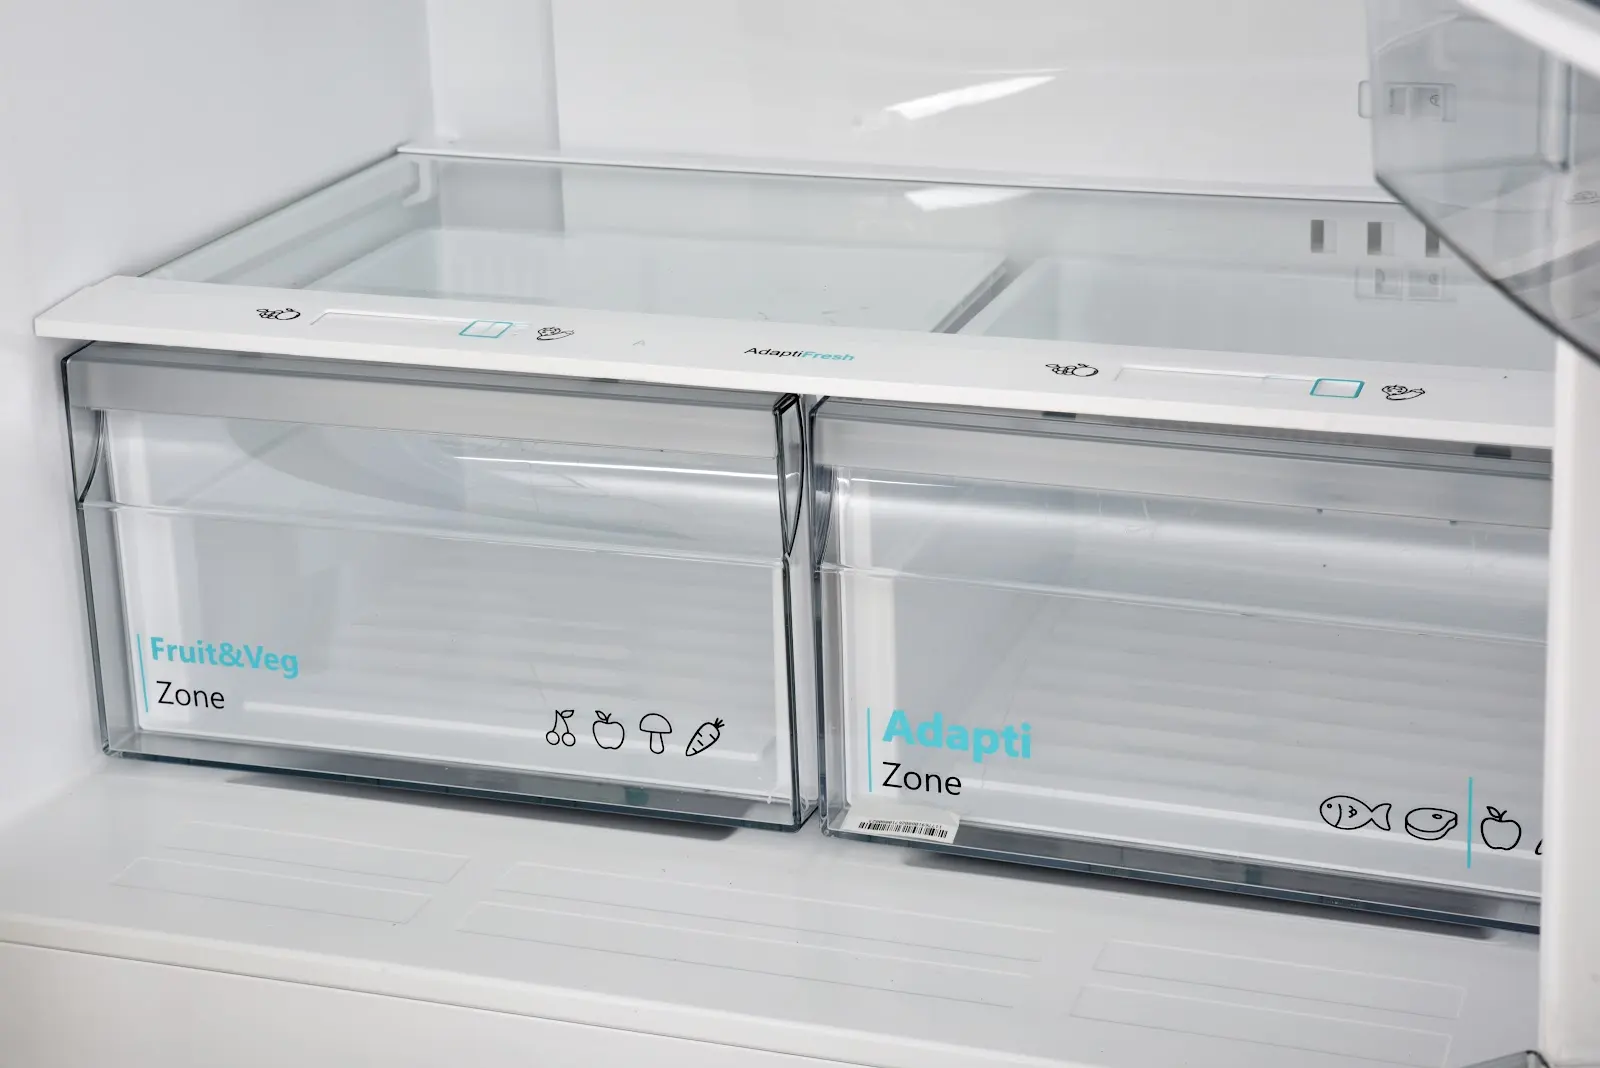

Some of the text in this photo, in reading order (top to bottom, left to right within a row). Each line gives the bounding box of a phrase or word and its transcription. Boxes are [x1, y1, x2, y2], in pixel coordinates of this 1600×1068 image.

[744, 347, 855, 361] AdaptiFresh
[150, 637, 299, 679] Fruit&Veg
[157, 681, 225, 709] Zone
[883, 709, 1032, 763] Adapti
[882, 762, 962, 795] Zone
